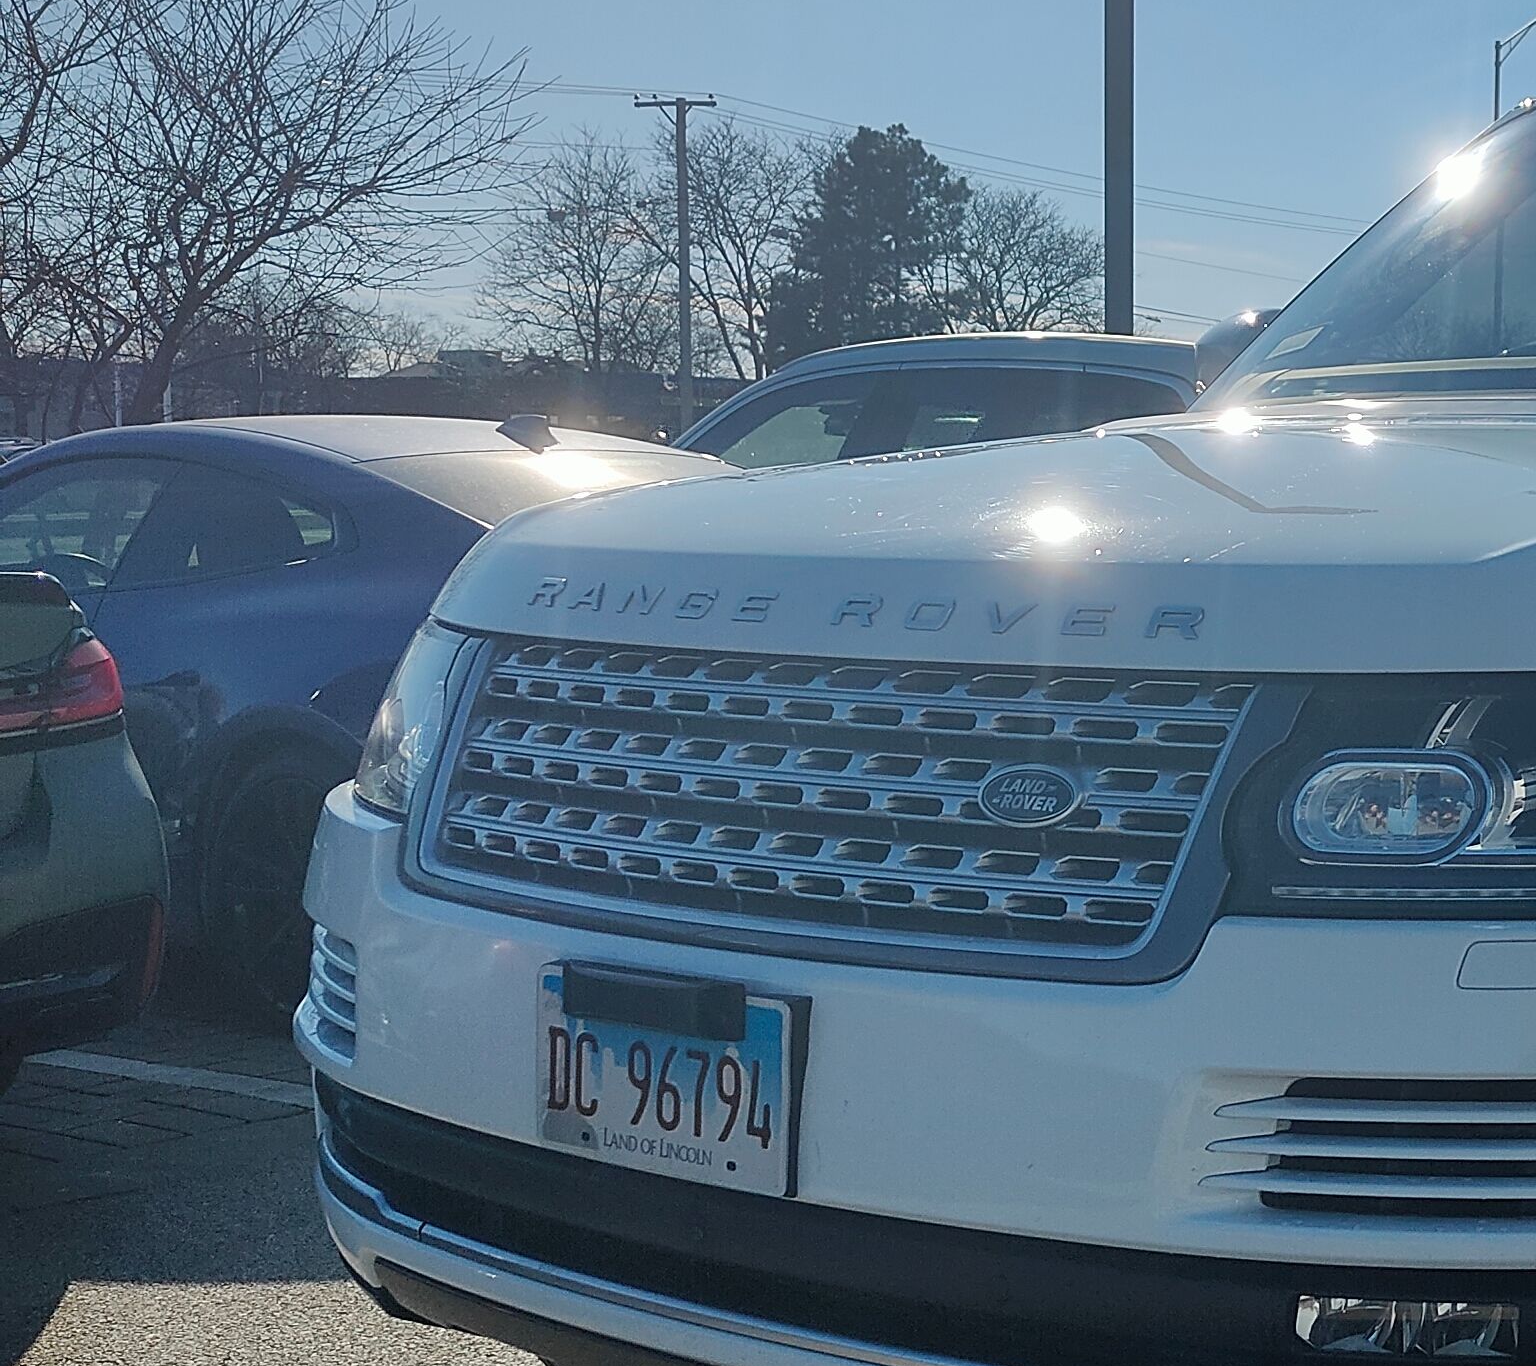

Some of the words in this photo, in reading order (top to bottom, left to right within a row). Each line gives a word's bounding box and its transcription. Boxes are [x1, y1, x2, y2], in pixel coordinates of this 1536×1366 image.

[527, 575, 781, 623] RANGE
[830, 592, 1205, 641] ROVER
[1000, 777, 1046, 794] LAND
[1000, 794, 1058, 812] ROVER
[548, 1025, 598, 1117] DC
[627, 1040, 772, 1149] 96794
[603, 1127, 638, 1153] LAND
[640, 1138, 657, 1156] OF
[660, 1138, 713, 1166] LINCOLN
